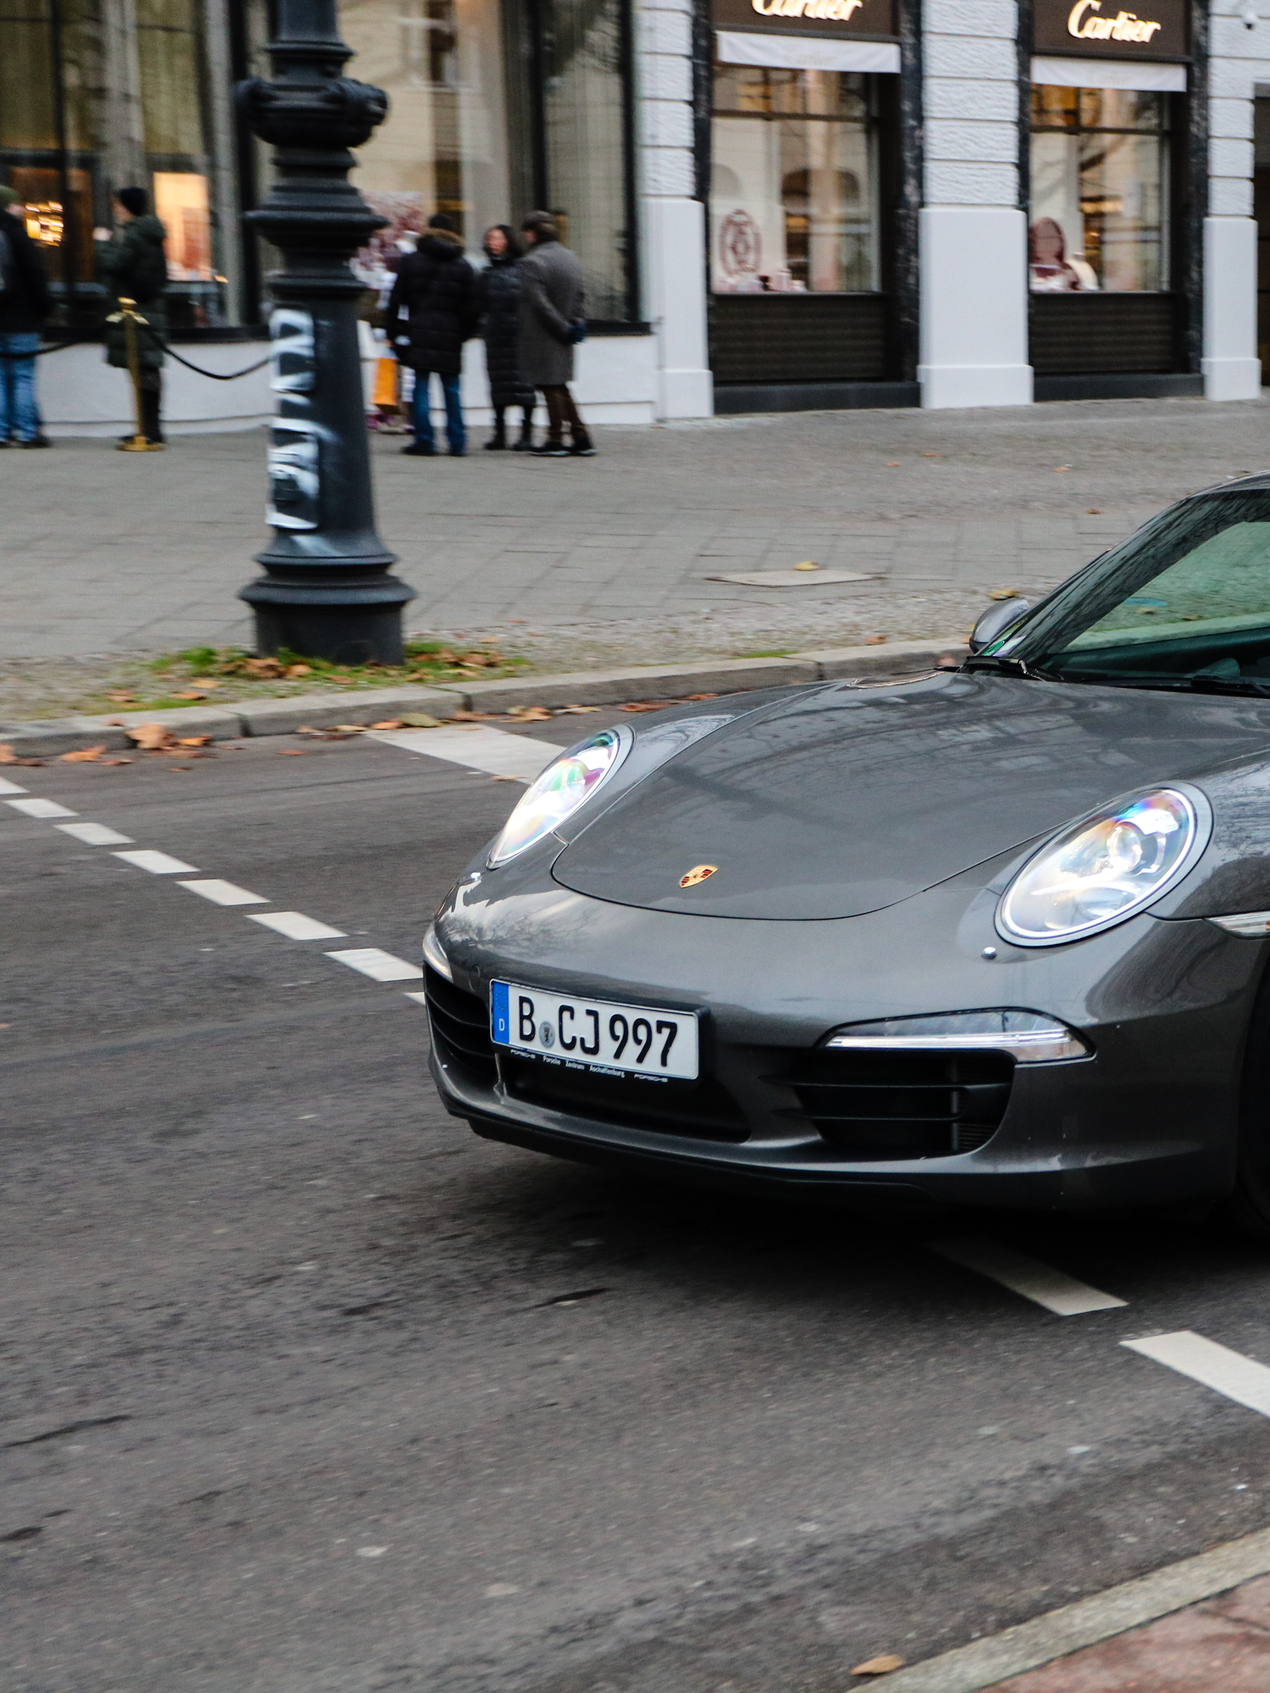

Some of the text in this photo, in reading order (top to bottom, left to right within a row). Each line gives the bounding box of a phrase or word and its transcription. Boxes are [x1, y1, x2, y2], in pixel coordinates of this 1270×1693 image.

[1068, 0, 1162, 43] Cartier
[498, 1018, 506, 1032] D
[518, 995, 678, 1067] B CJ 997
